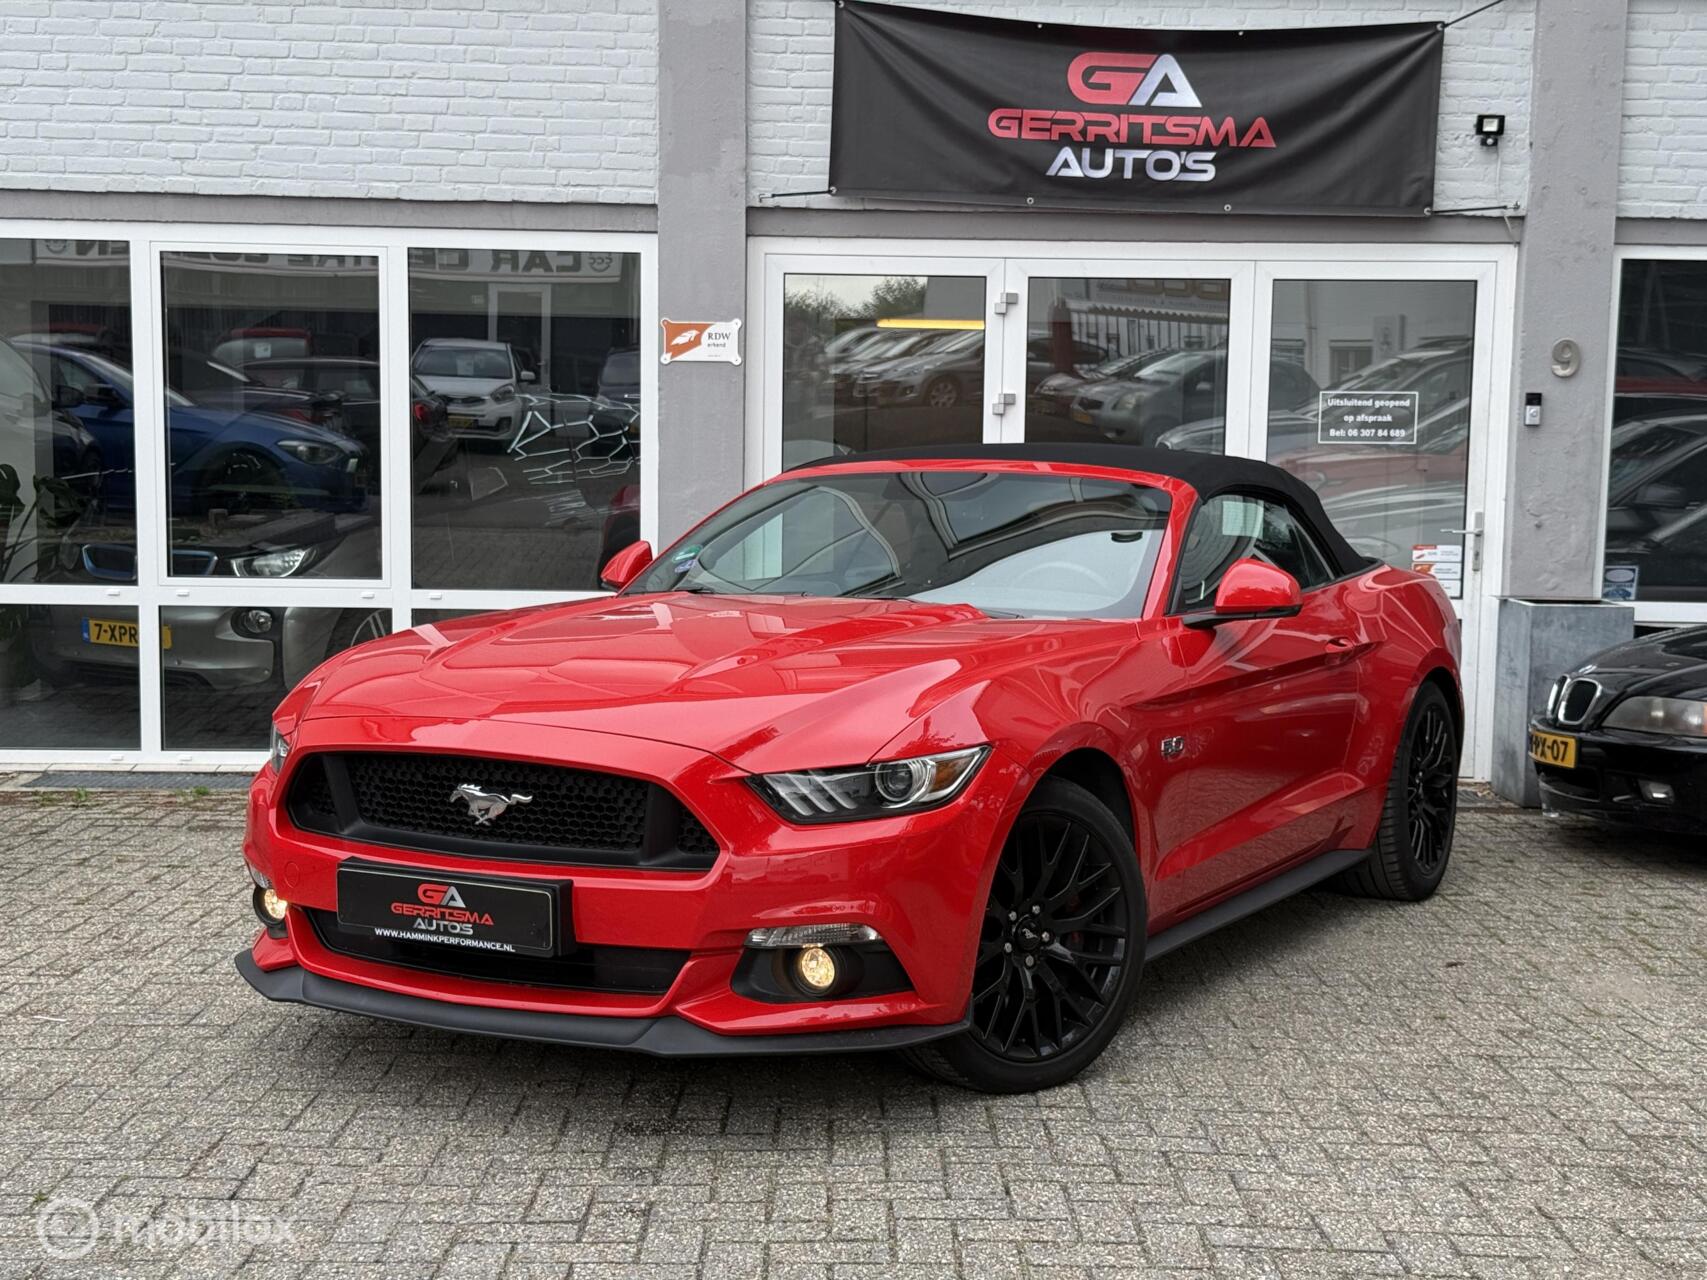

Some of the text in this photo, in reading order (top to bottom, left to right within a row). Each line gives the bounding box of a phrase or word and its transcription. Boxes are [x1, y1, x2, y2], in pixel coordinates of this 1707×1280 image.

[1066, 51, 1203, 108] GA
[987, 107, 1277, 148] GERRITSMA
[1045, 146, 1217, 182] AUTO'S
[707, 332, 731, 341] RDW
[1551, 337, 1581, 379] 9
[1327, 398, 1410, 409] Uitsluitend geopend
[1343, 414, 1393, 423] op afspraak
[1329, 428, 1406, 438] Bel: 06 307 84 689
[93, 622, 138, 644] 7-XPR
[417, 883, 467, 908] GA
[390, 902, 495, 926] GERRITSMA
[412, 917, 474, 935] AUTO'S
[374, 927, 516, 952] WWW.HAMMINKPERFORMANCE.NL
